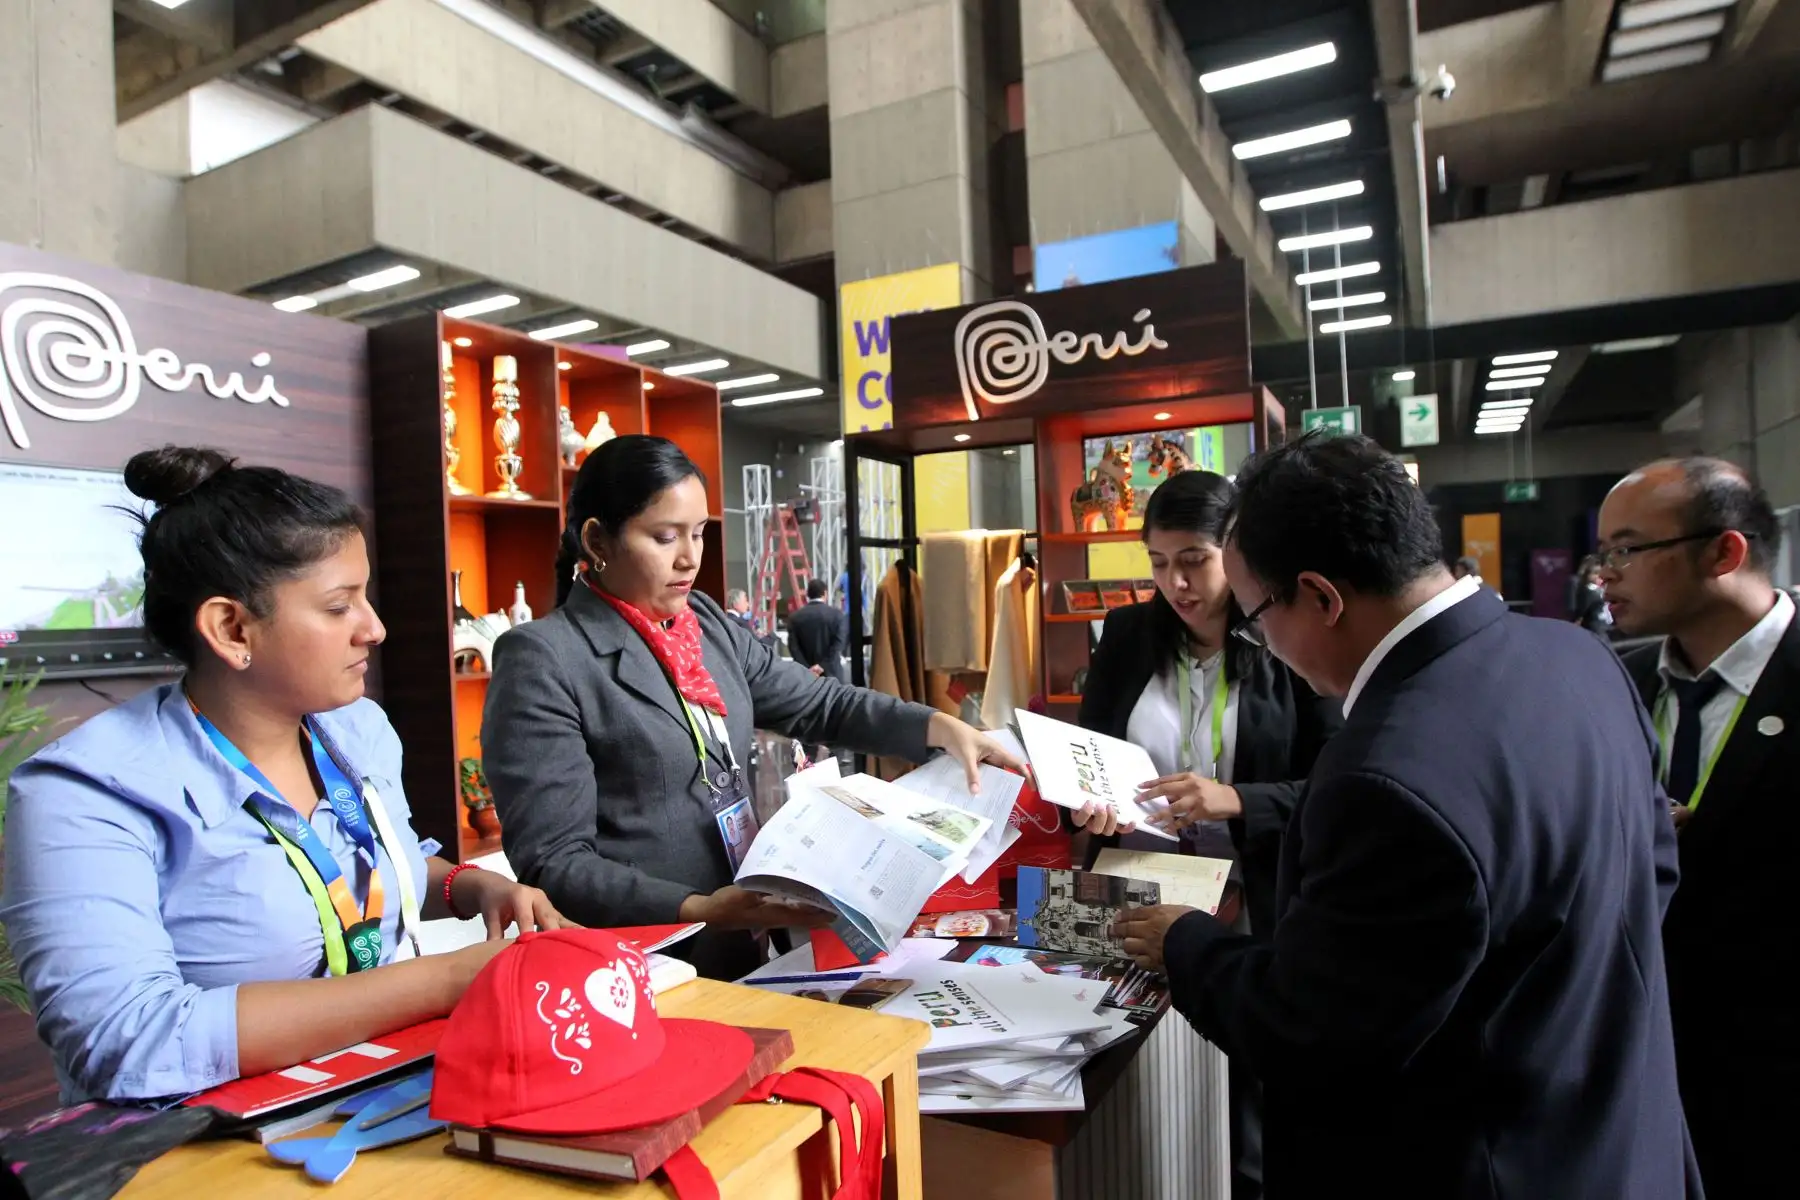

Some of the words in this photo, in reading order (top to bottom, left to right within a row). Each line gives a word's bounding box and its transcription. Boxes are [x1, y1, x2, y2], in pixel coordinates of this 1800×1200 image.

[954, 301, 1168, 421] Perú
[1070, 742, 1102, 797] Peru
[913, 991, 973, 1028] Peru
[940, 979, 976, 1006] senses
